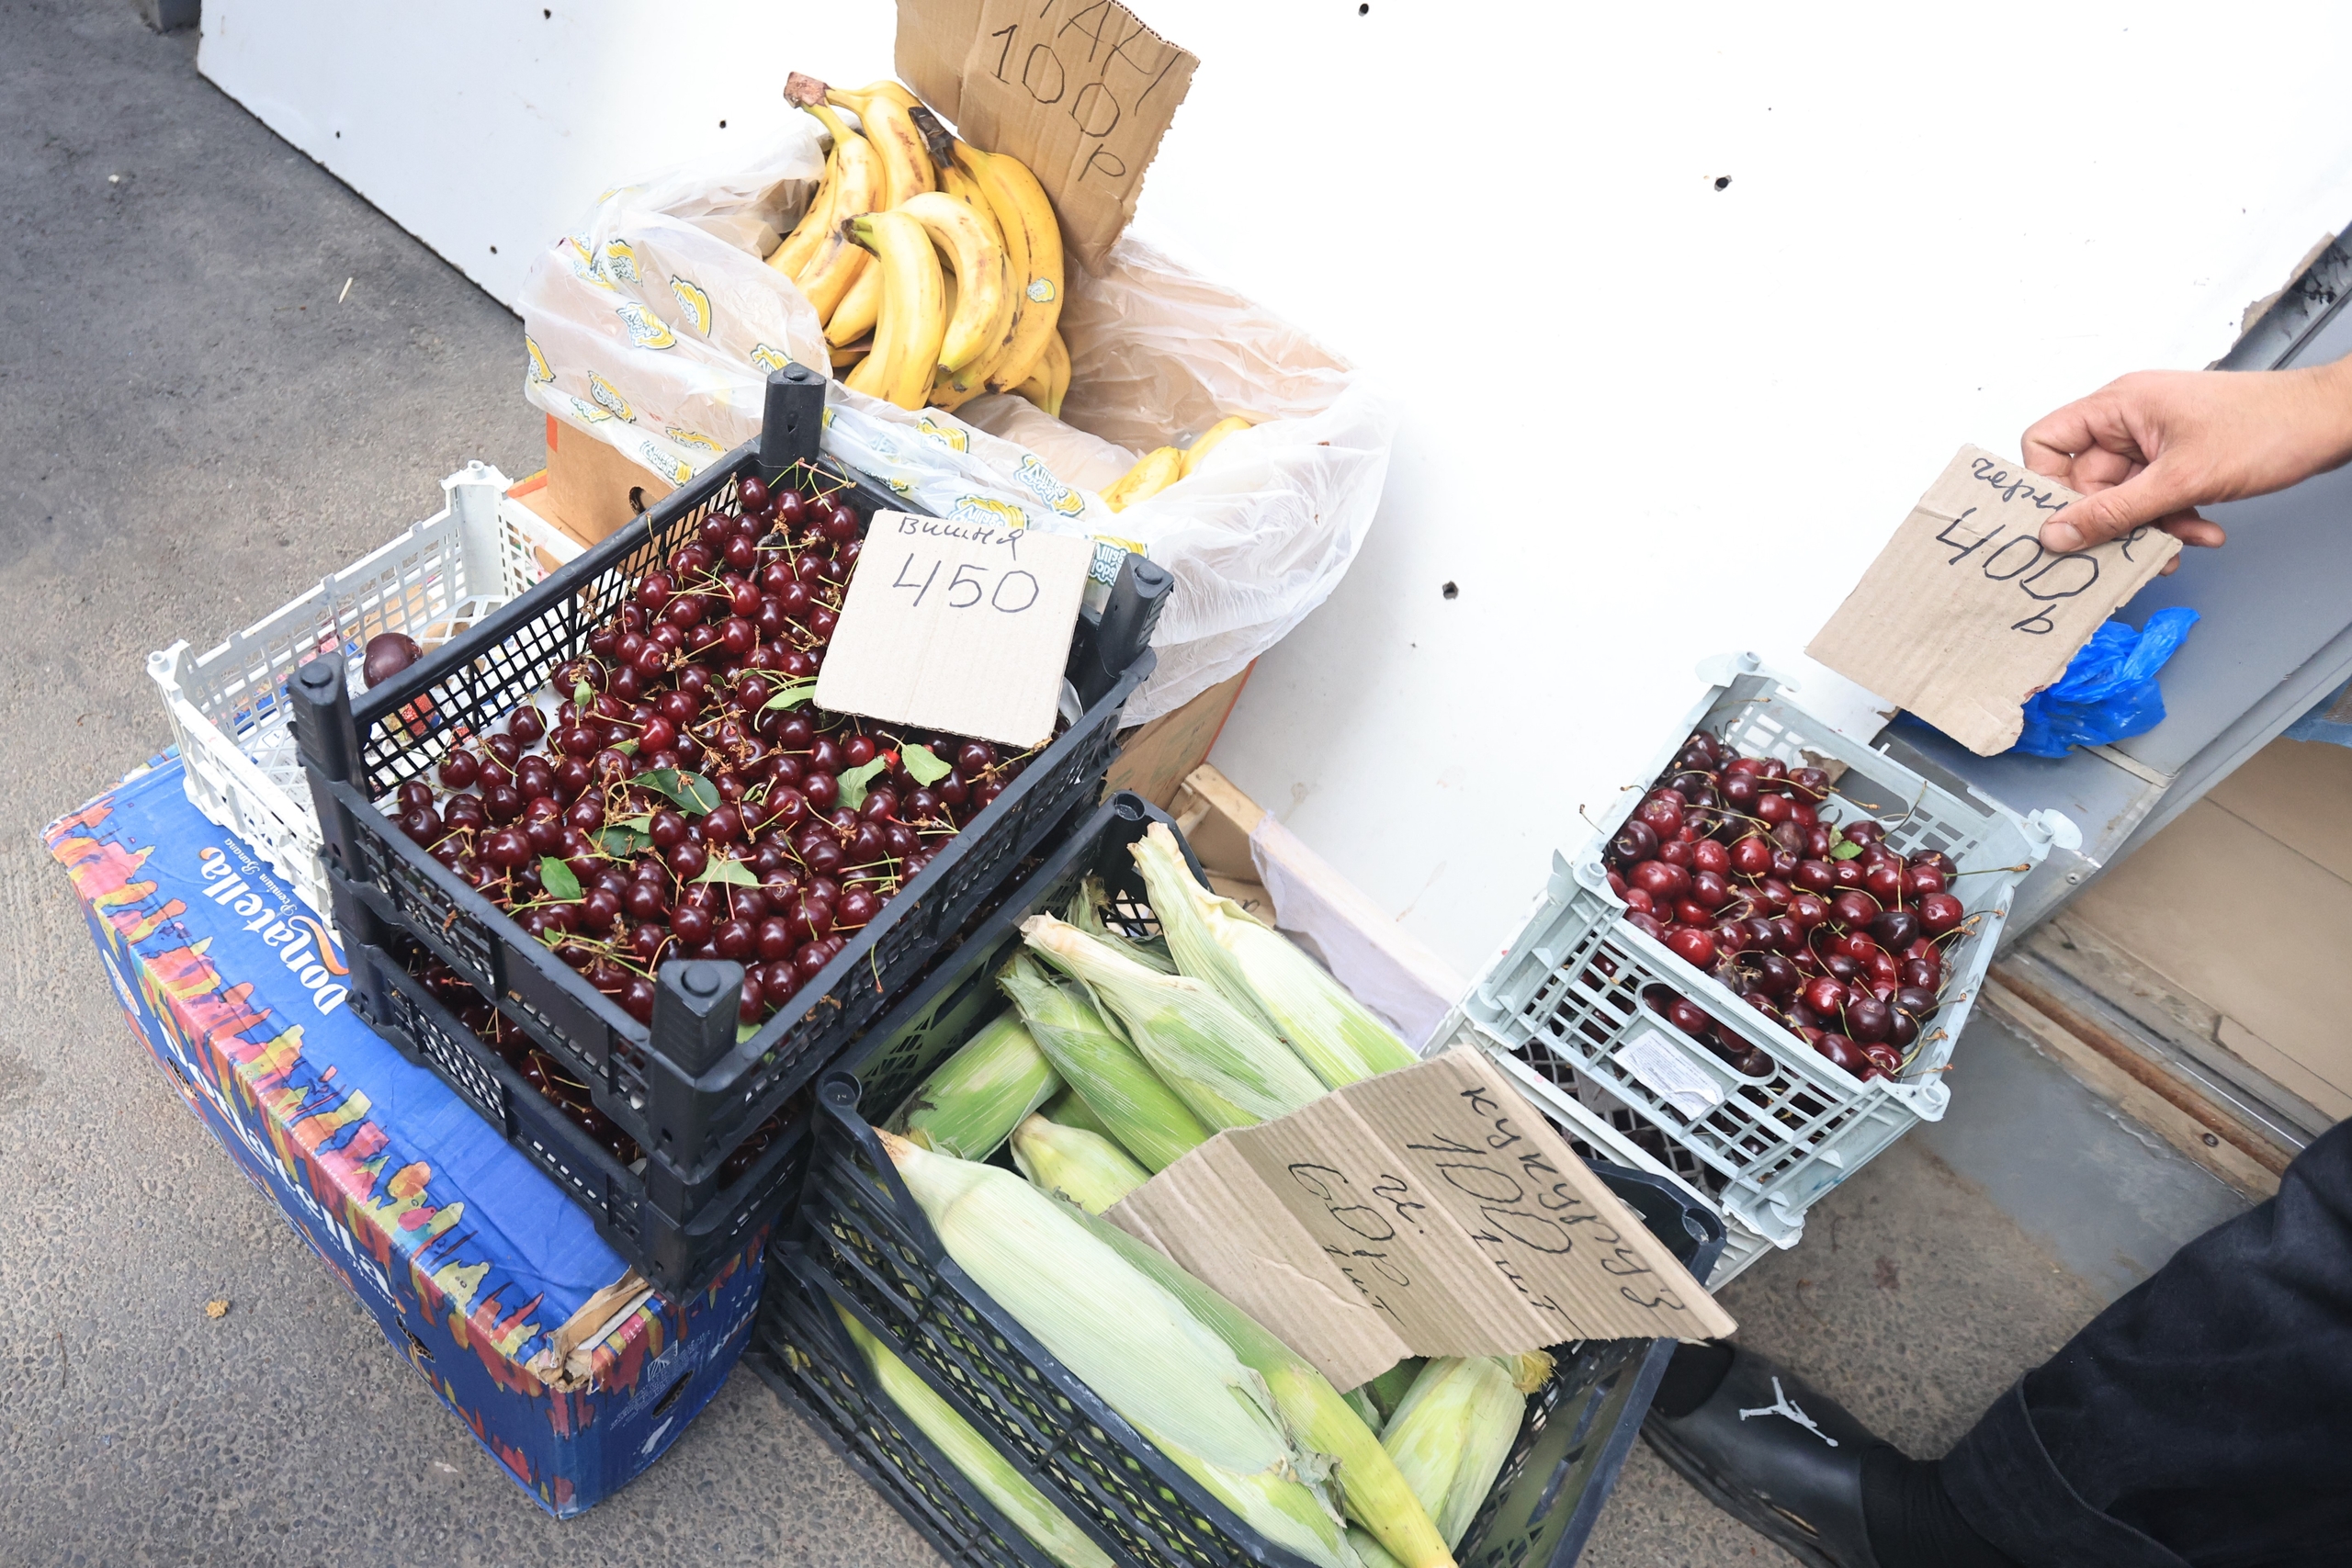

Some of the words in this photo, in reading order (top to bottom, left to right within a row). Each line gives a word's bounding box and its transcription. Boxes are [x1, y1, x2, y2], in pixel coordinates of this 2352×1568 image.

[990, 23, 1121, 138] 100
[892, 552, 1040, 614] 450
[1934, 506, 2100, 601] 400
[223, 837, 261, 876] Banana
[199, 846, 350, 1016] Donatella
[156, 1019, 396, 1300] Donatella
[1406, 1133, 1573, 1255] 100
